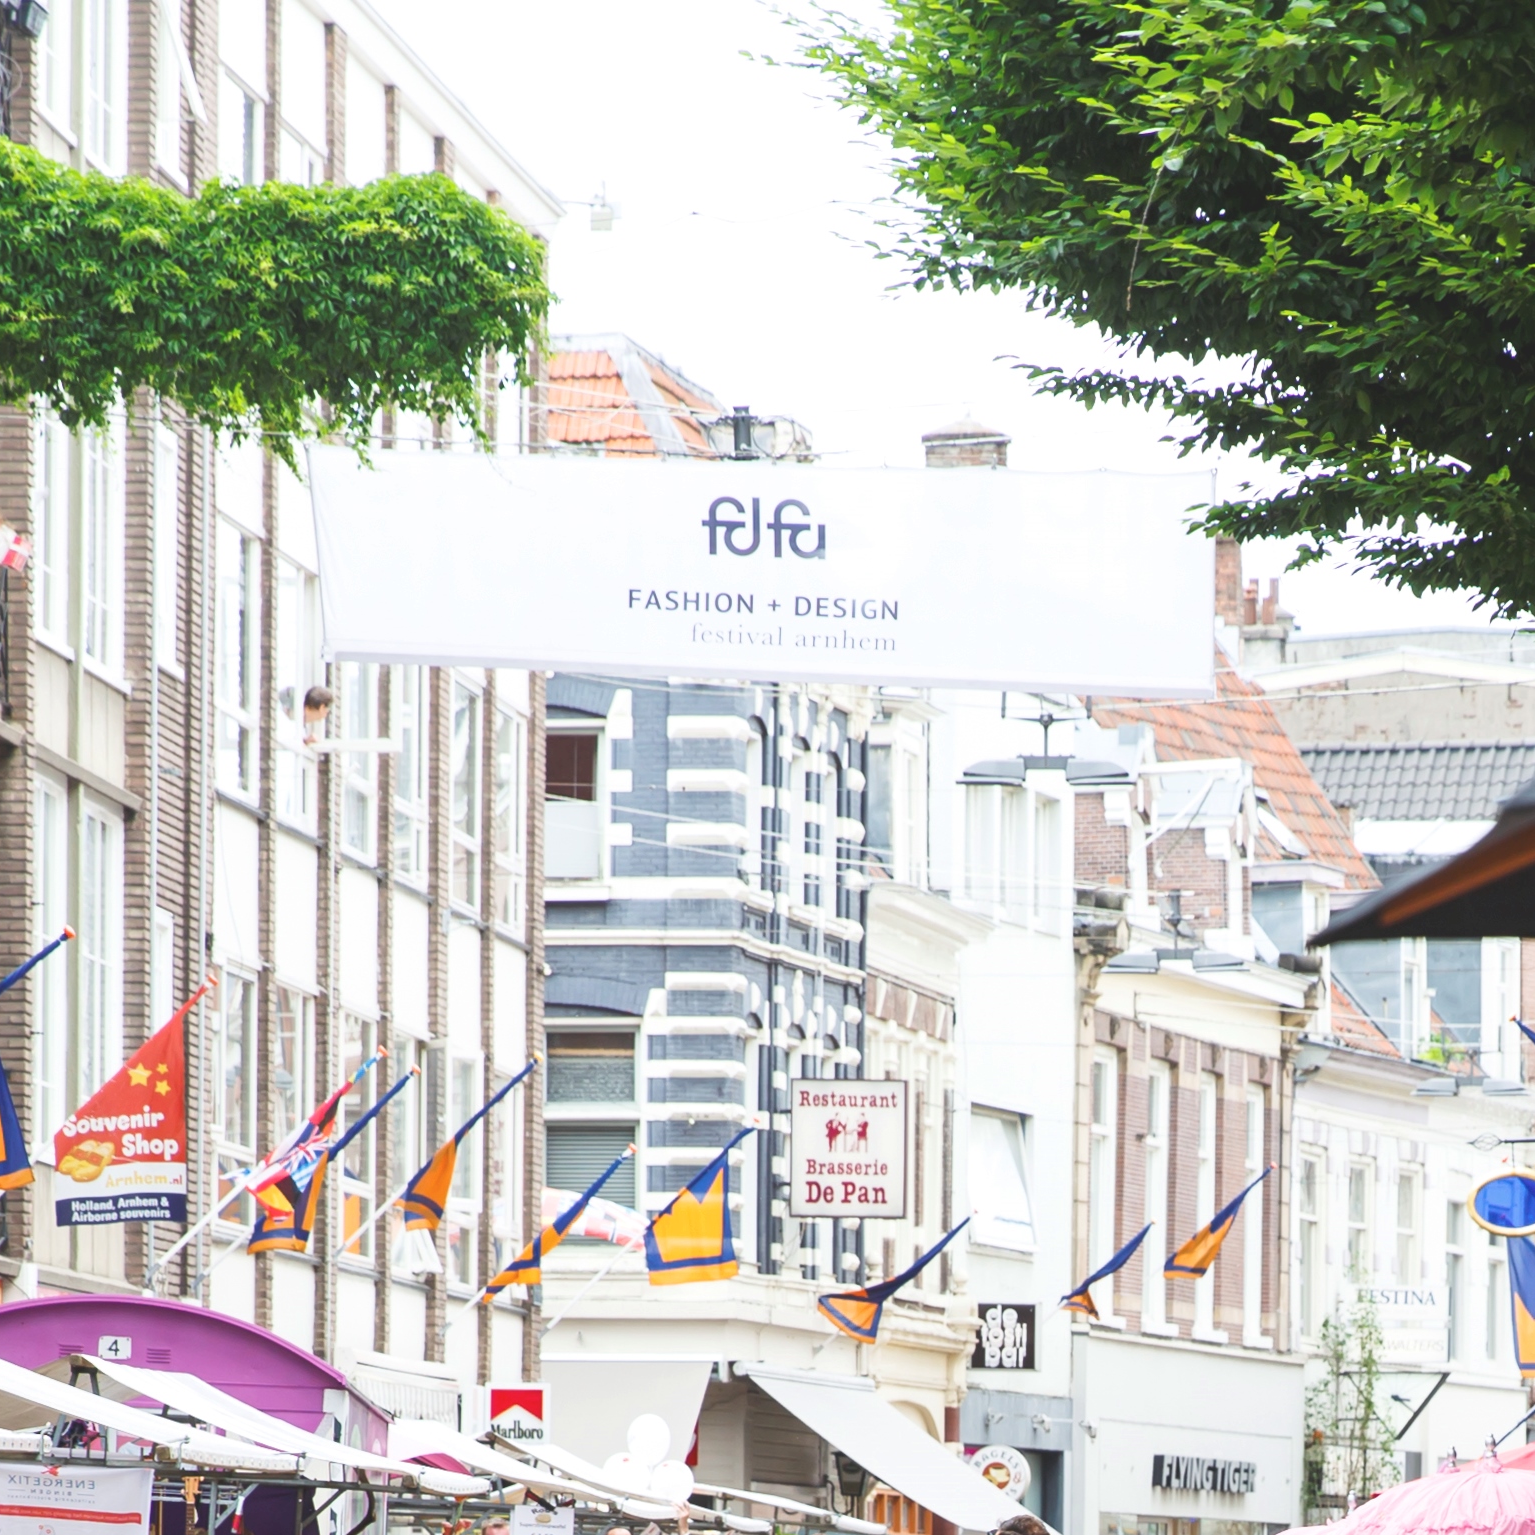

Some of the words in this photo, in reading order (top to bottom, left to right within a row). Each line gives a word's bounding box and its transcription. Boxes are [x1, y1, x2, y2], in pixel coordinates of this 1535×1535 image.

[627, 587, 754, 615] FASHION
[767, 598, 782, 610] +
[794, 595, 899, 621] DESIGN
[691, 622, 783, 647] festival
[795, 628, 896, 652] arnhem
[799, 1090, 898, 1108] Restaurant
[62, 1105, 165, 1137] Souvenir
[121, 1133, 179, 1161] Shop
[806, 1159, 888, 1175] Brasserie
[71, 1199, 115, 1212] Holland,
[117, 1196, 158, 1208] Arnhem
[160, 1197, 169, 1207] &
[805, 1180, 835, 1203] De
[841, 1181, 888, 1204] Pan
[71, 1211, 118, 1222] Airborne
[120, 1207, 171, 1219] souvenirs
[986, 1304, 1018, 1330] de
[108, 1339, 120, 1356] 4
[491, 1420, 543, 1439] Marlboro
[1161, 1455, 1214, 1492] FLYING
[1214, 1459, 1257, 1493] TIGER
